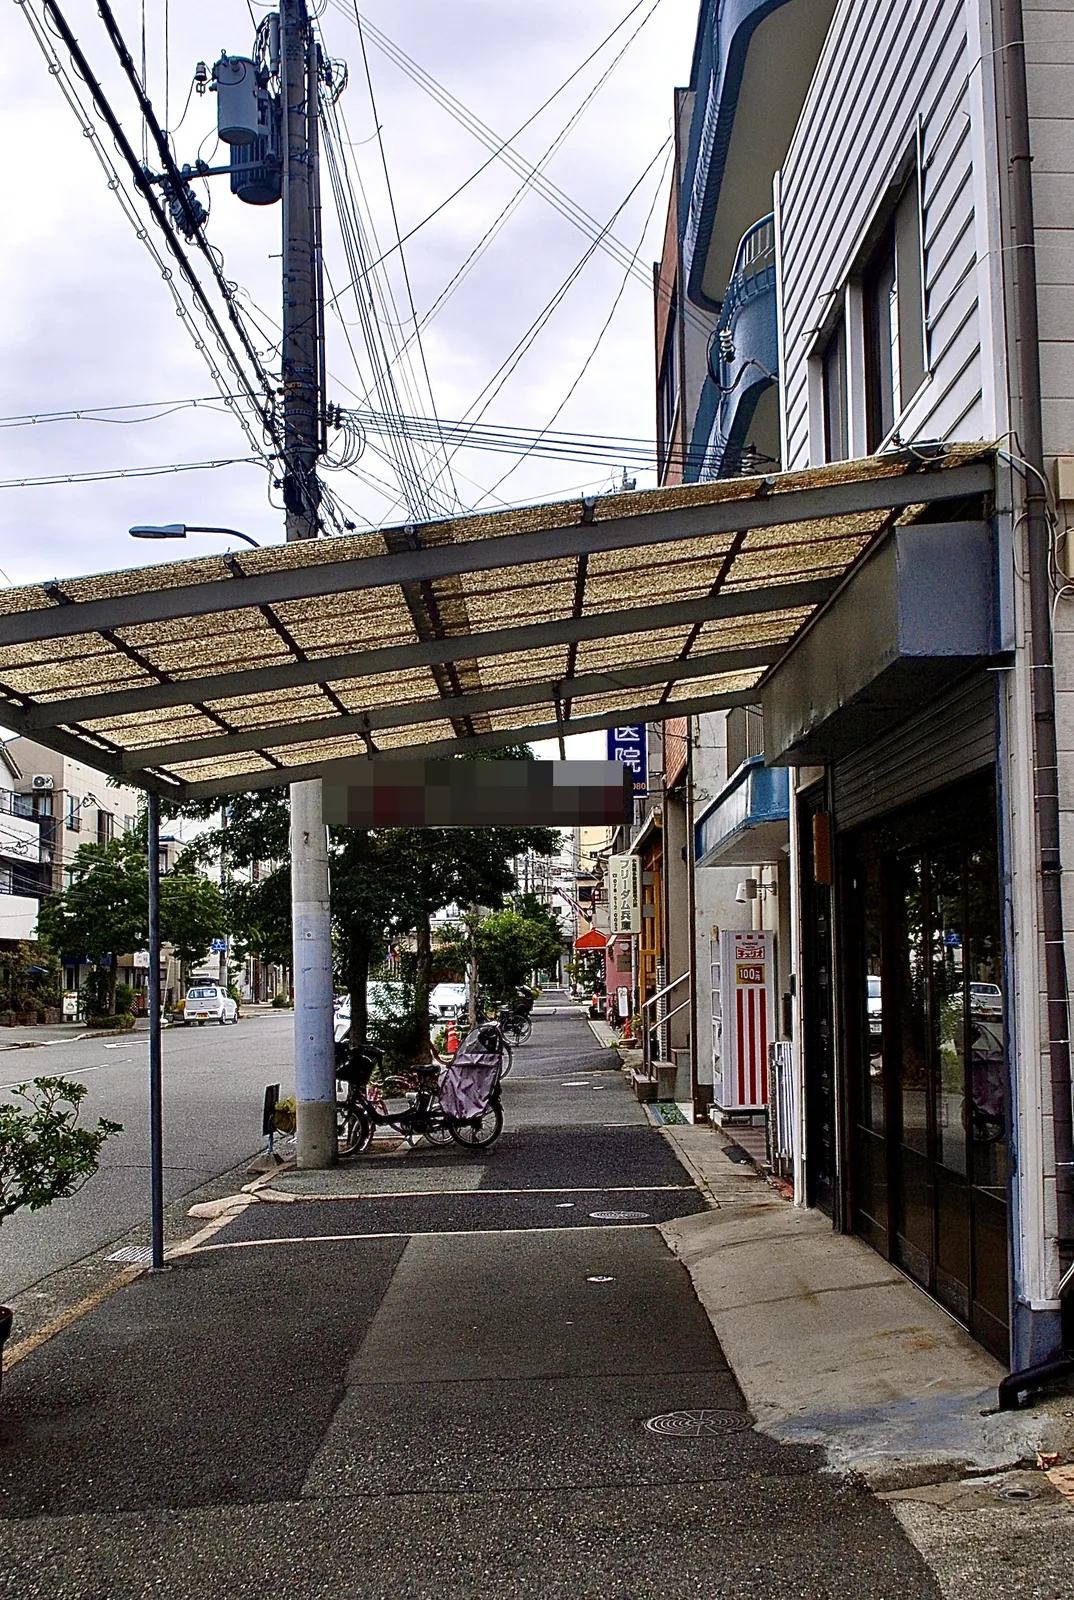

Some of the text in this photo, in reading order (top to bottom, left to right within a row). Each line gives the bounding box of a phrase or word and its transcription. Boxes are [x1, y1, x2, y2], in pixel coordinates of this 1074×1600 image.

[620, 859, 631, 931] フリーダム兵庫
